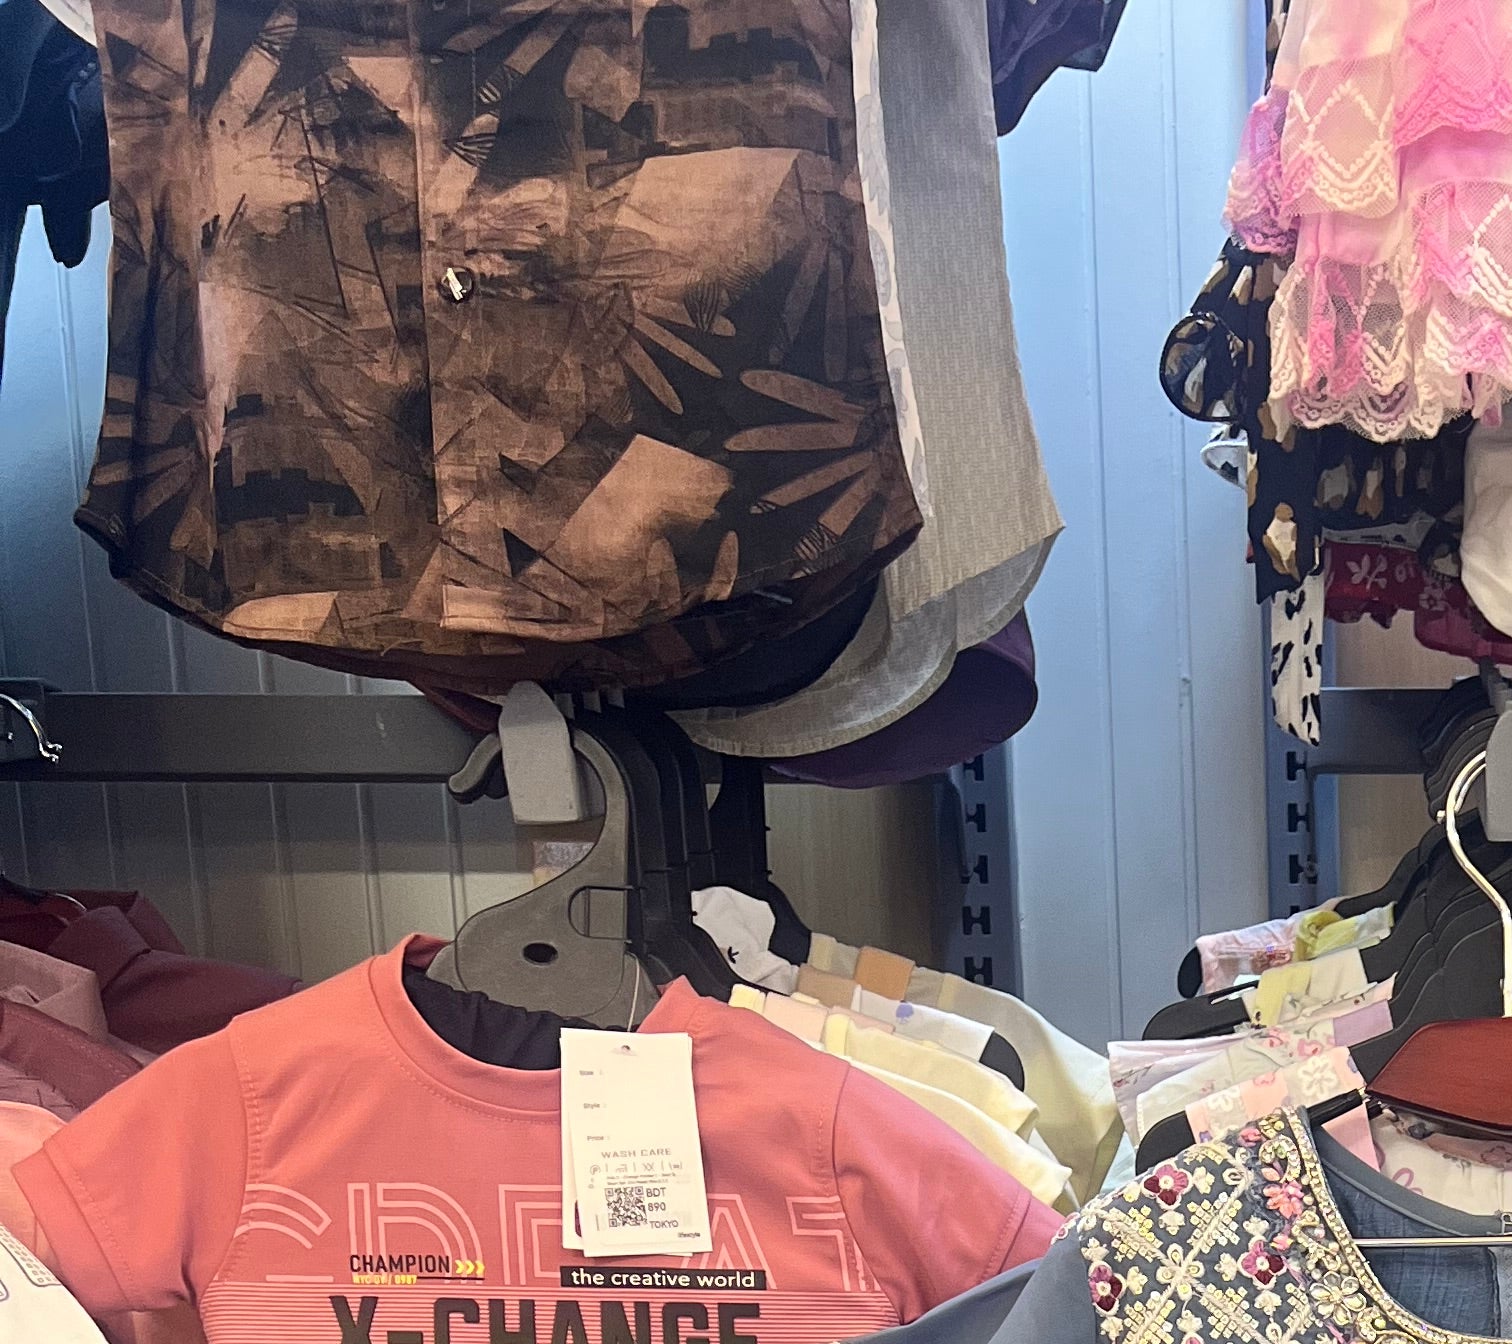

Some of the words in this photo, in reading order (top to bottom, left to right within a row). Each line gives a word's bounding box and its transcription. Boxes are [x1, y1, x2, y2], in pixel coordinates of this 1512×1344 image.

[601, 1149, 636, 1159] WASH
[640, 1147, 672, 1157] CARE
[646, 1186, 667, 1198] BDT
[647, 1201, 666, 1212] 890
[648, 1219, 679, 1229] TOKYO
[349, 1254, 451, 1274] CHAMPION
[571, 1268, 605, 1286] the
[610, 1269, 691, 1287] creative
[696, 1271, 756, 1288] world
